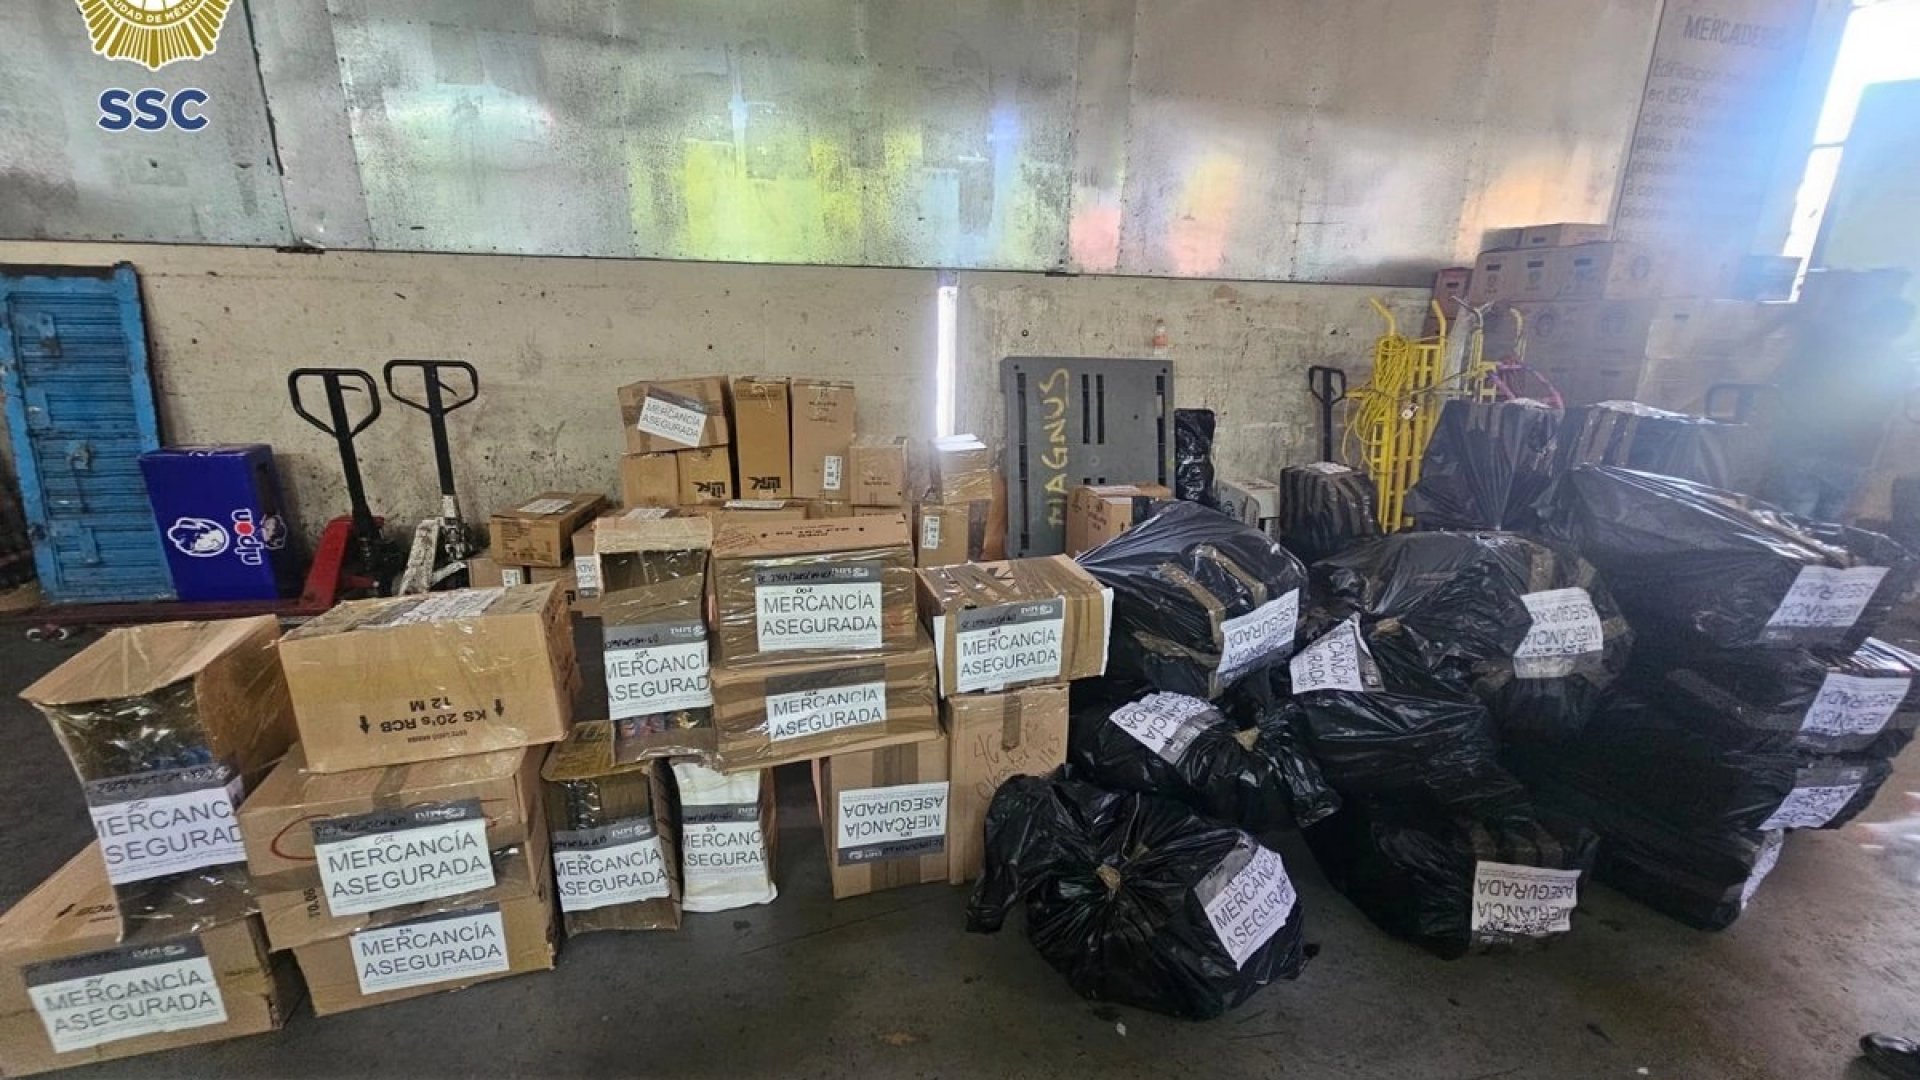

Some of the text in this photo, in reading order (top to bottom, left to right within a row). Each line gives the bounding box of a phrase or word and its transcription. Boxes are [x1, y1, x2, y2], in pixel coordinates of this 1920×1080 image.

[764, 590, 875, 614] MERCANCÍA
[762, 616, 878, 637] ASEGURADA
[963, 626, 1057, 657] MERCANCÍA
[961, 649, 1057, 677] ASEGURADA
[609, 675, 709, 702] SEGURAD
[773, 687, 878, 716] MERCANCÍA
[410, 700, 425, 713] M
[380, 709, 487, 733] KS 20's RCB
[774, 707, 882, 738] ASEGURADA
[97, 800, 230, 838] ERCANC
[842, 796, 944, 819] ASEGURADA
[844, 814, 941, 840] MERCANCÍA
[328, 829, 478, 873] MERCANCÍA
[684, 845, 768, 867] SEGURA
[332, 855, 486, 897] ASEGURADA
[1478, 879, 1575, 900] ASEGURADA
[361, 921, 496, 957] MERCANCÍA
[364, 943, 502, 978] ASEGURADA
[42, 968, 206, 1010] MERCANCÍA
[55, 990, 216, 1033] ASEGURADA
